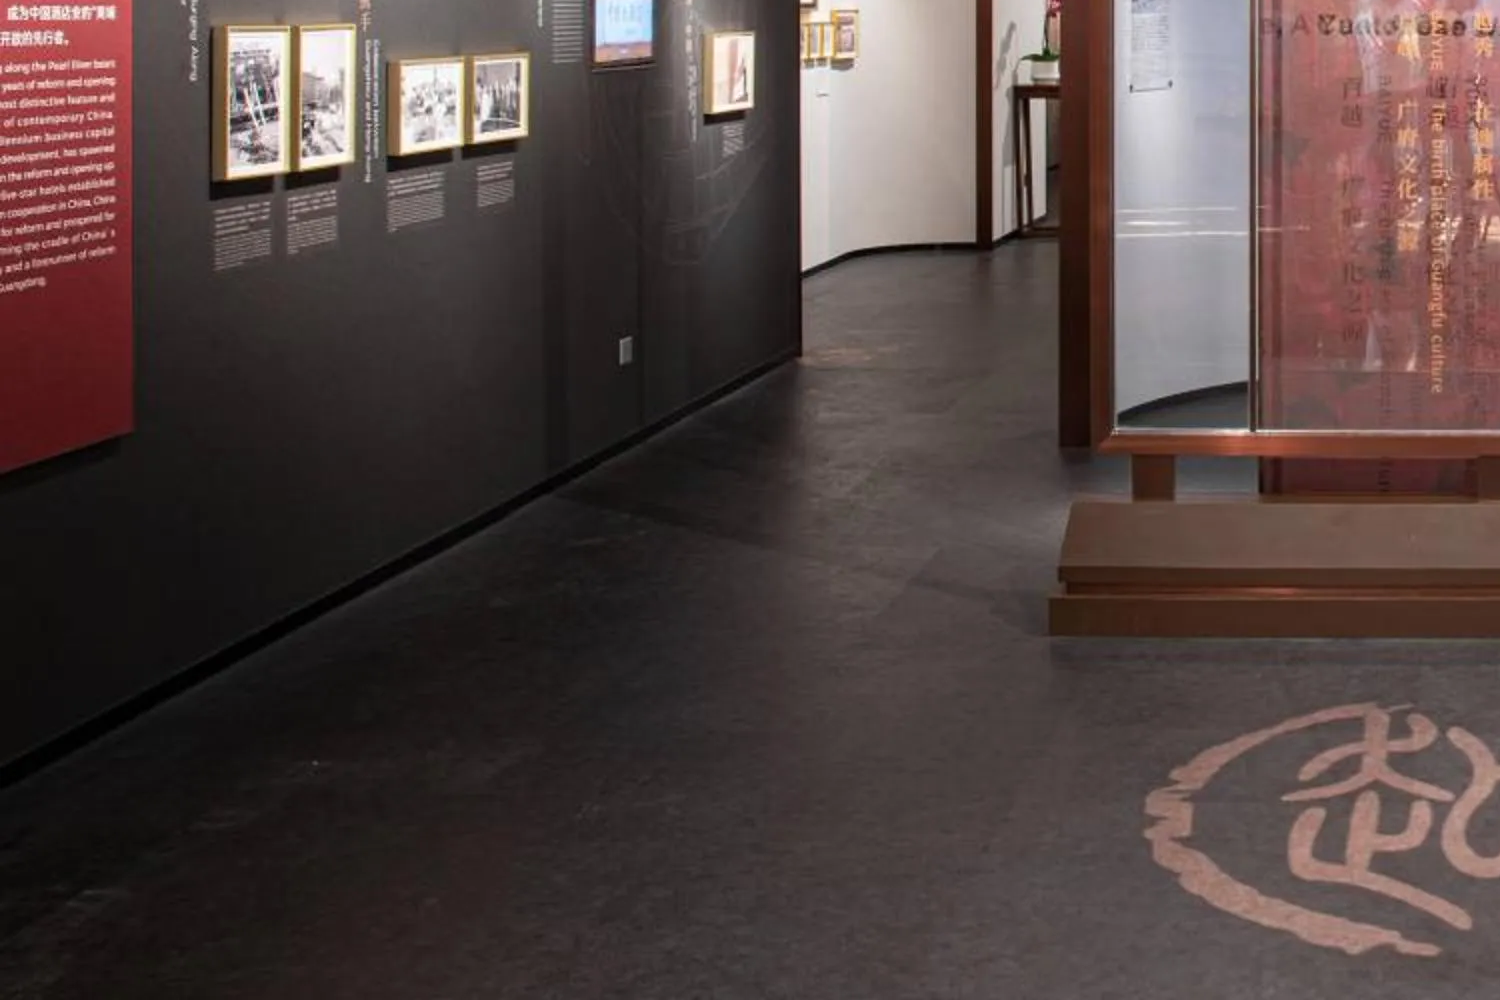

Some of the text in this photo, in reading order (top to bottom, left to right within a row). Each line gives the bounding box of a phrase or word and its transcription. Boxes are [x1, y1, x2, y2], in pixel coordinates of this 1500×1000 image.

[31, 61, 47, 73] the
[1431, 103, 1446, 132] The
[8, 171, 22, 183] the
[1428, 260, 1447, 328] Guangfu
[1430, 334, 1446, 394] culture
